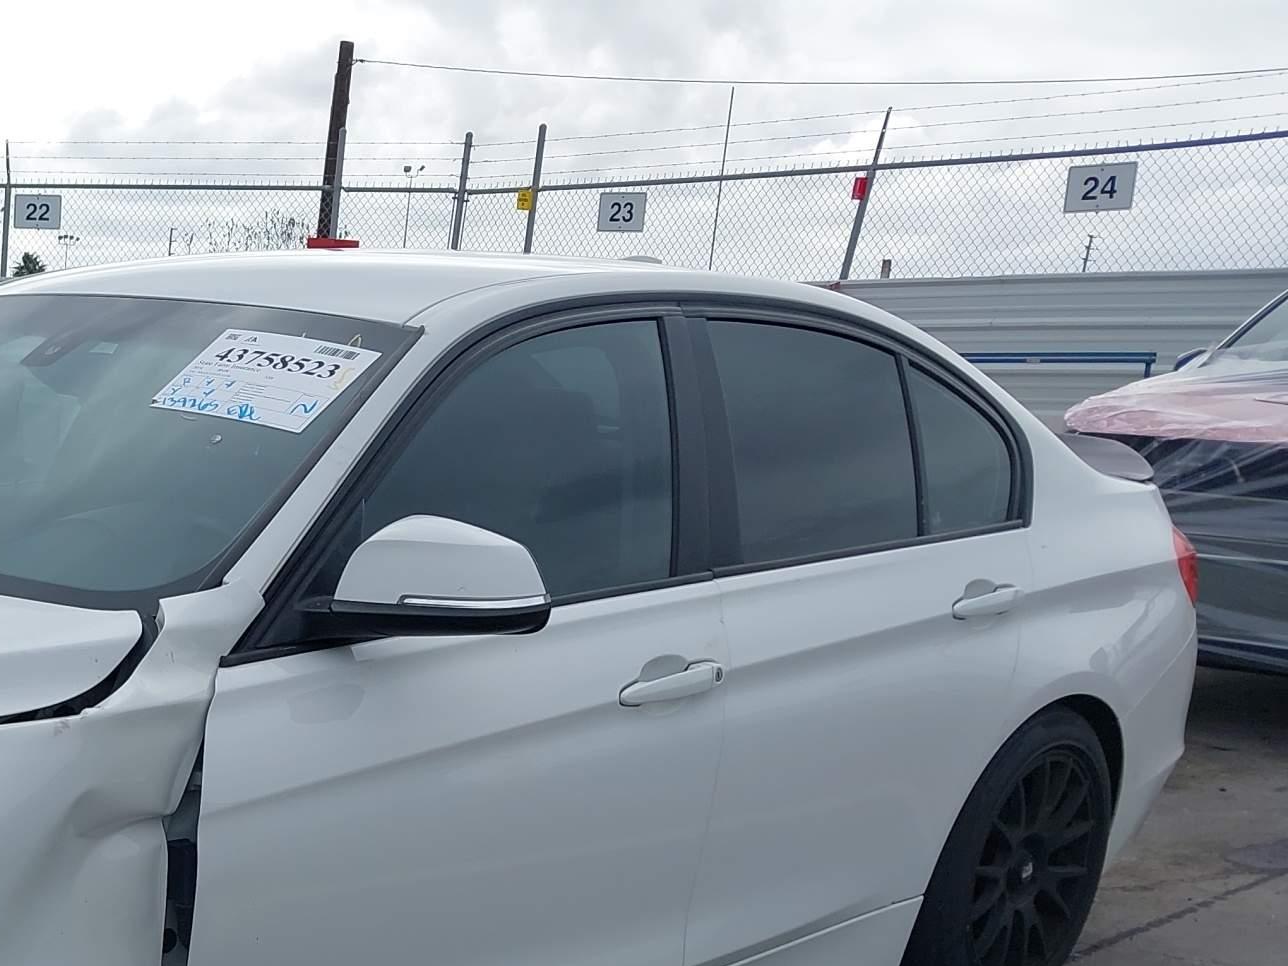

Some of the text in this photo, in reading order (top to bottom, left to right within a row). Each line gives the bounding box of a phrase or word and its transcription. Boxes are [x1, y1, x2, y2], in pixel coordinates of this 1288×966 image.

[1081, 175, 1118, 201] 24
[25, 203, 51, 221] 22
[609, 201, 634, 222] 23
[215, 347, 341, 379] 43758523
